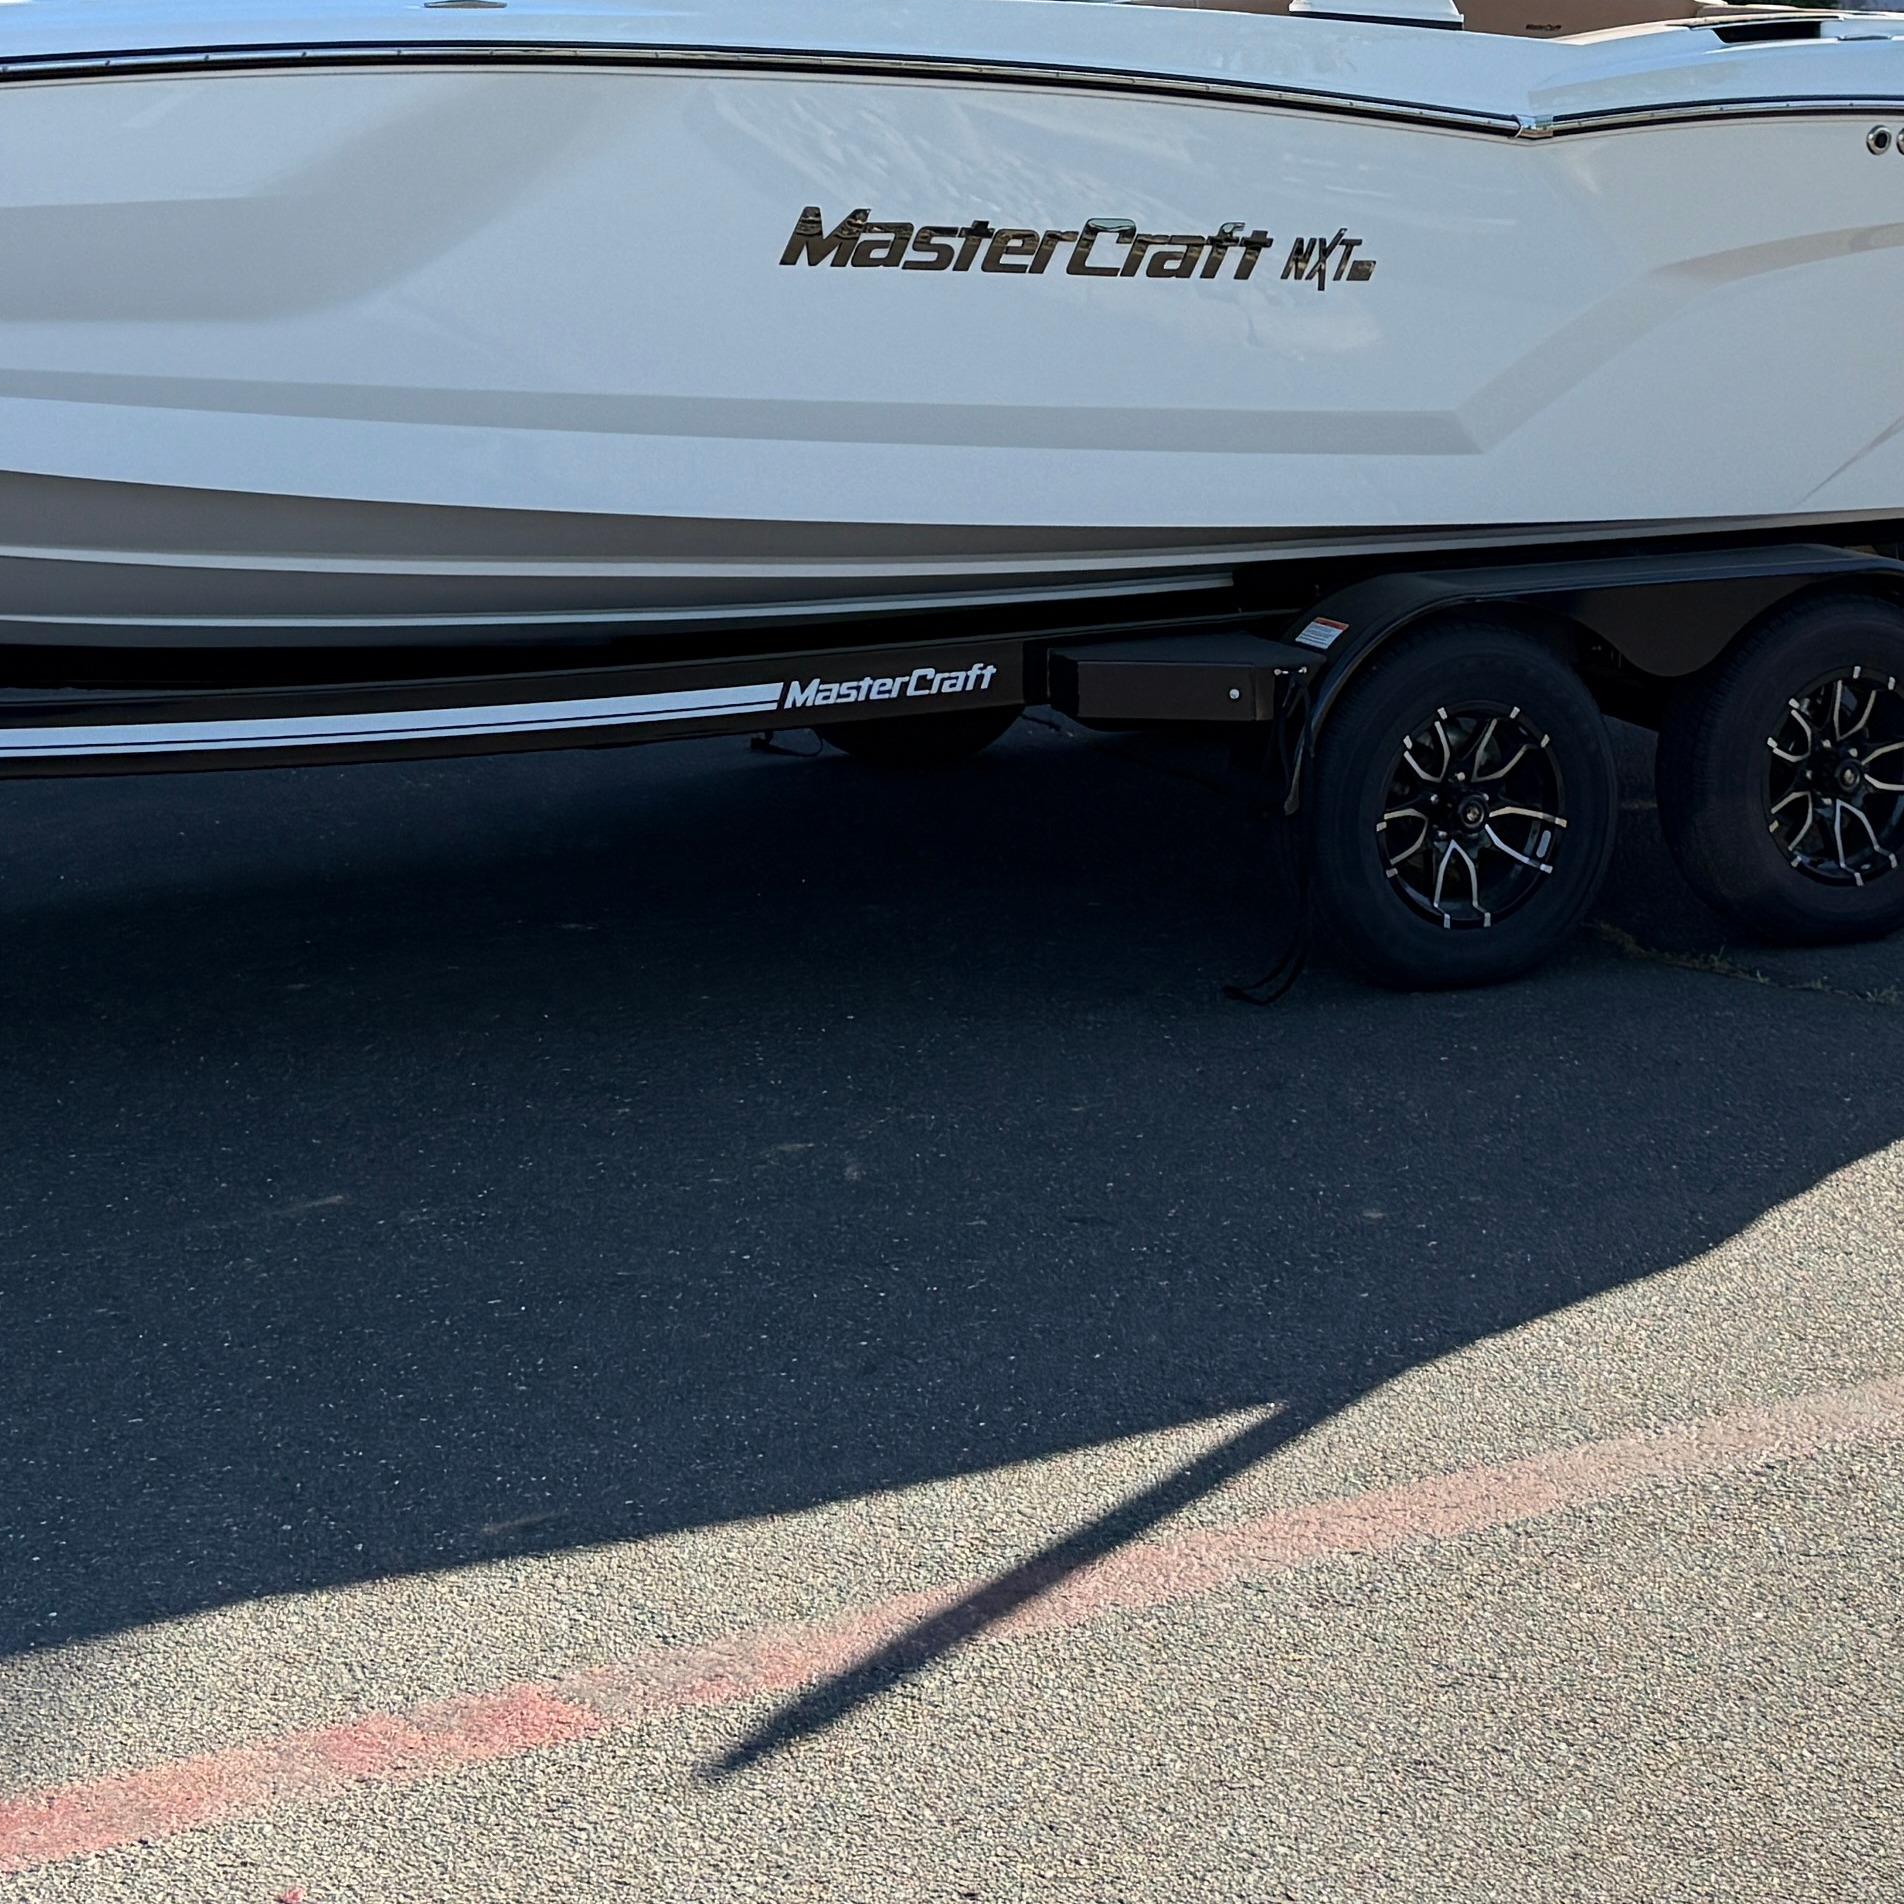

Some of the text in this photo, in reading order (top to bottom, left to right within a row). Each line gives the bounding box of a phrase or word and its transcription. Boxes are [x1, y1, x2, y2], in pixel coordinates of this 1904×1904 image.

[779, 206, 1363, 291] MasterCraft NXT
[783, 663, 997, 710] MasterCraft
